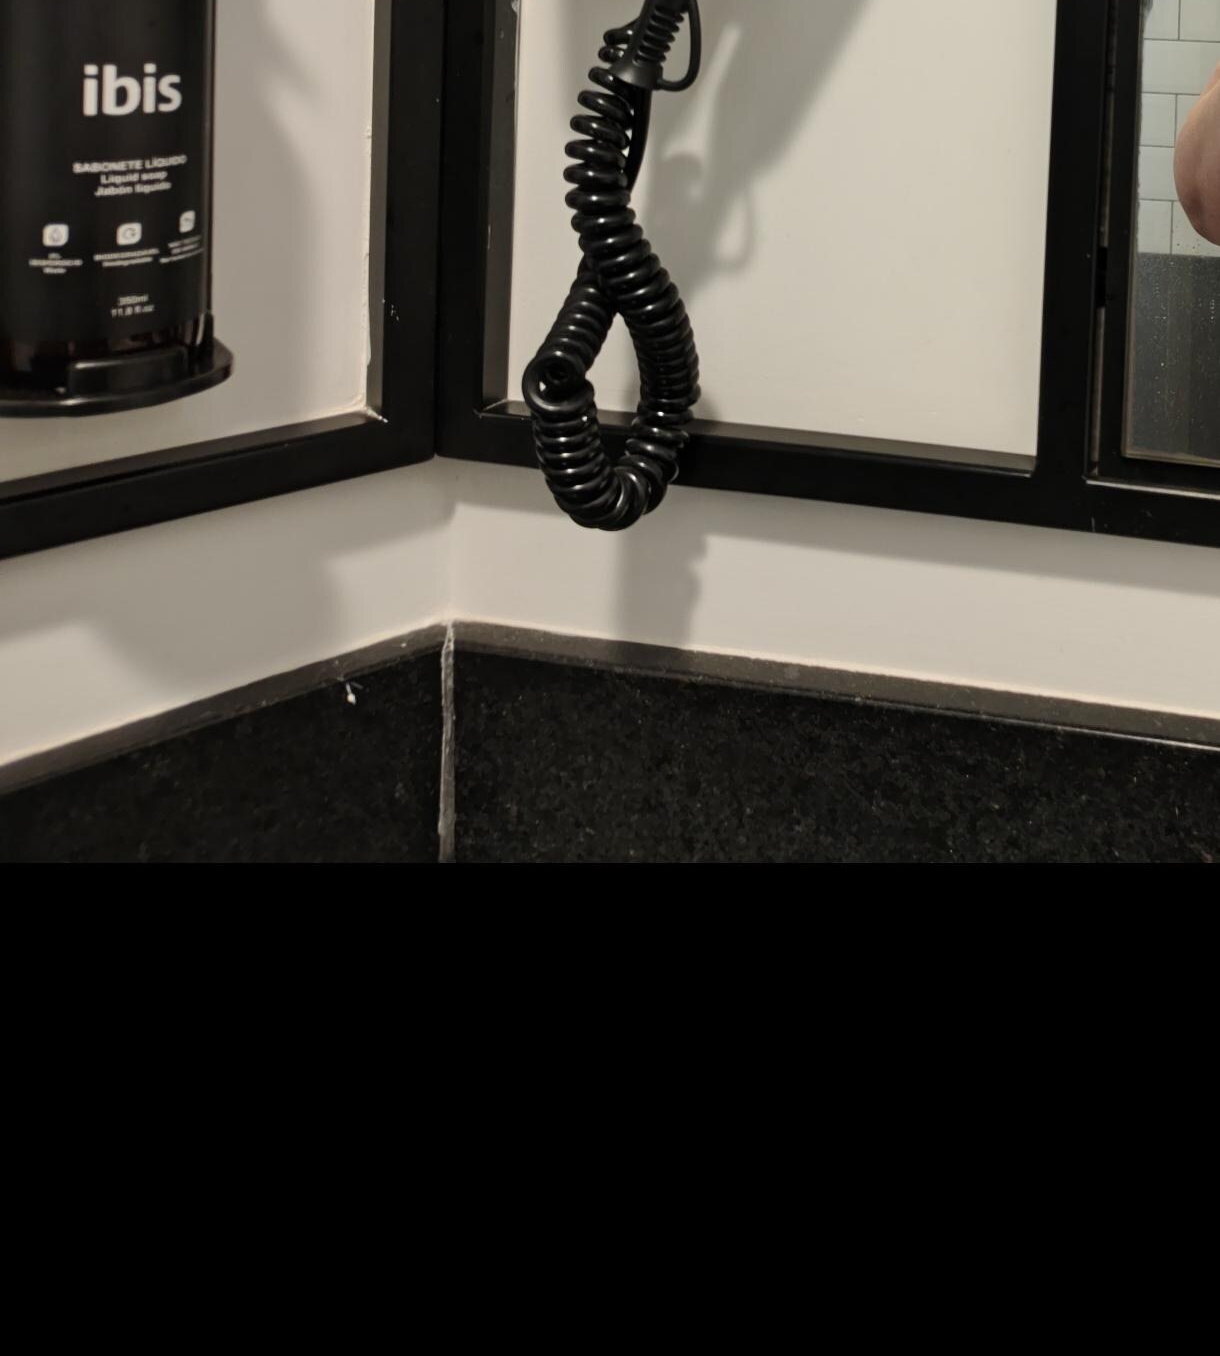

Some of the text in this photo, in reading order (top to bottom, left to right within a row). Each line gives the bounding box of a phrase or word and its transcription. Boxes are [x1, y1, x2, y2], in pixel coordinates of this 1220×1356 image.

[83, 63, 182, 116] ibis
[73, 159, 143, 173] SABONETE
[101, 173, 139, 184] Liquid
